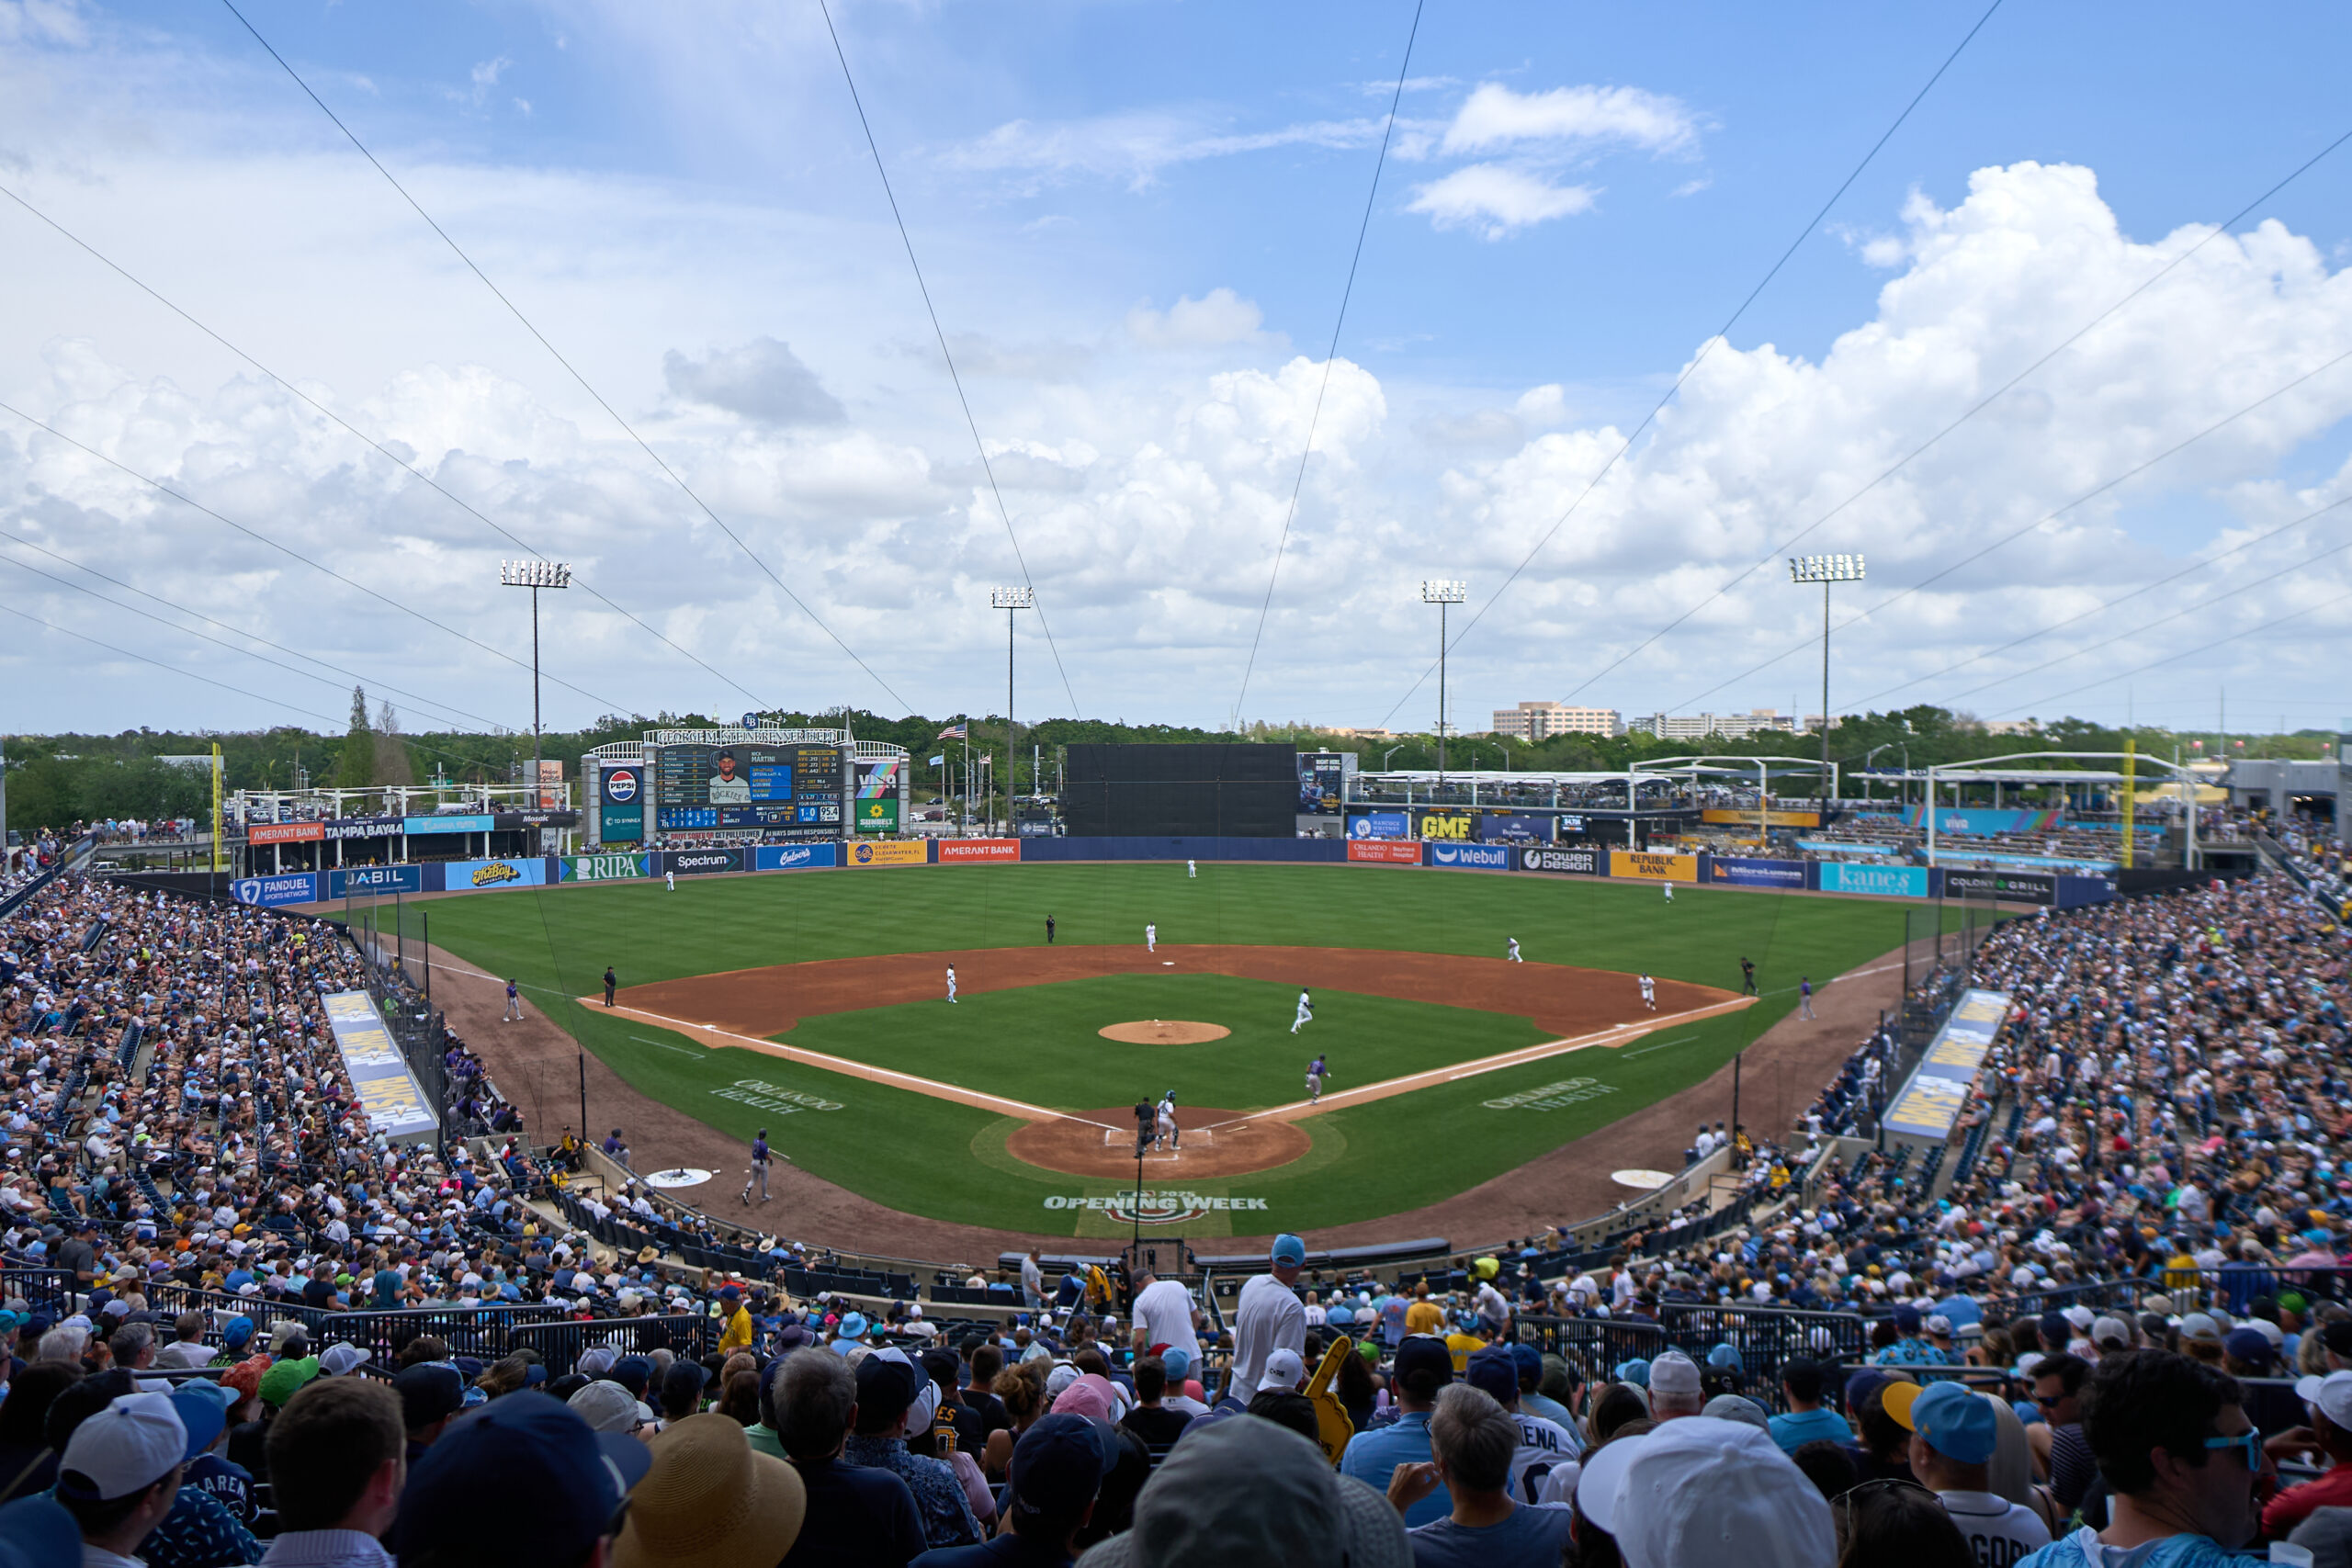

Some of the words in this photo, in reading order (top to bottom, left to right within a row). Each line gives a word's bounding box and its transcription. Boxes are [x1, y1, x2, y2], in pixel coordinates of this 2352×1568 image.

[745, 716, 755, 726] TB
[660, 730, 704, 741] GEORGE
[707, 730, 719, 740] M.
[722, 729, 802, 741] STEINBRENNER
[804, 730, 836, 740] FIELD
[254, 829, 294, 840] AMERANT
[296, 827, 319, 836] BANK
[325, 826, 366, 838] TAMPA
[1422, 817, 1471, 838] GMF
[678, 854, 727, 868] Spectrum
[780, 847, 810, 865] Culver's
[1460, 850, 1505, 864] Webull
[1631, 854, 1676, 865] REPUBLIC
[594, 855, 638, 877] RIPA
[1639, 865, 1667, 874] BANK
[345, 870, 402, 885] JABIL
[1838, 864, 1910, 887] kane's
[265, 878, 309, 892] FANDUEL
[1951, 877, 1994, 887] COLONY
[2008, 881, 2050, 891] GRILL
[265, 892, 283, 900] SPORTS
[735, 1079, 843, 1111] ORLANDO
[1483, 1077, 1597, 1109] ORLANDO
[1522, 1085, 1620, 1111] HEALTH
[708, 1087, 805, 1114] HEALTH
[1044, 1196, 1177, 1210] OPENING
[1183, 1197, 1268, 1210] WEEK
